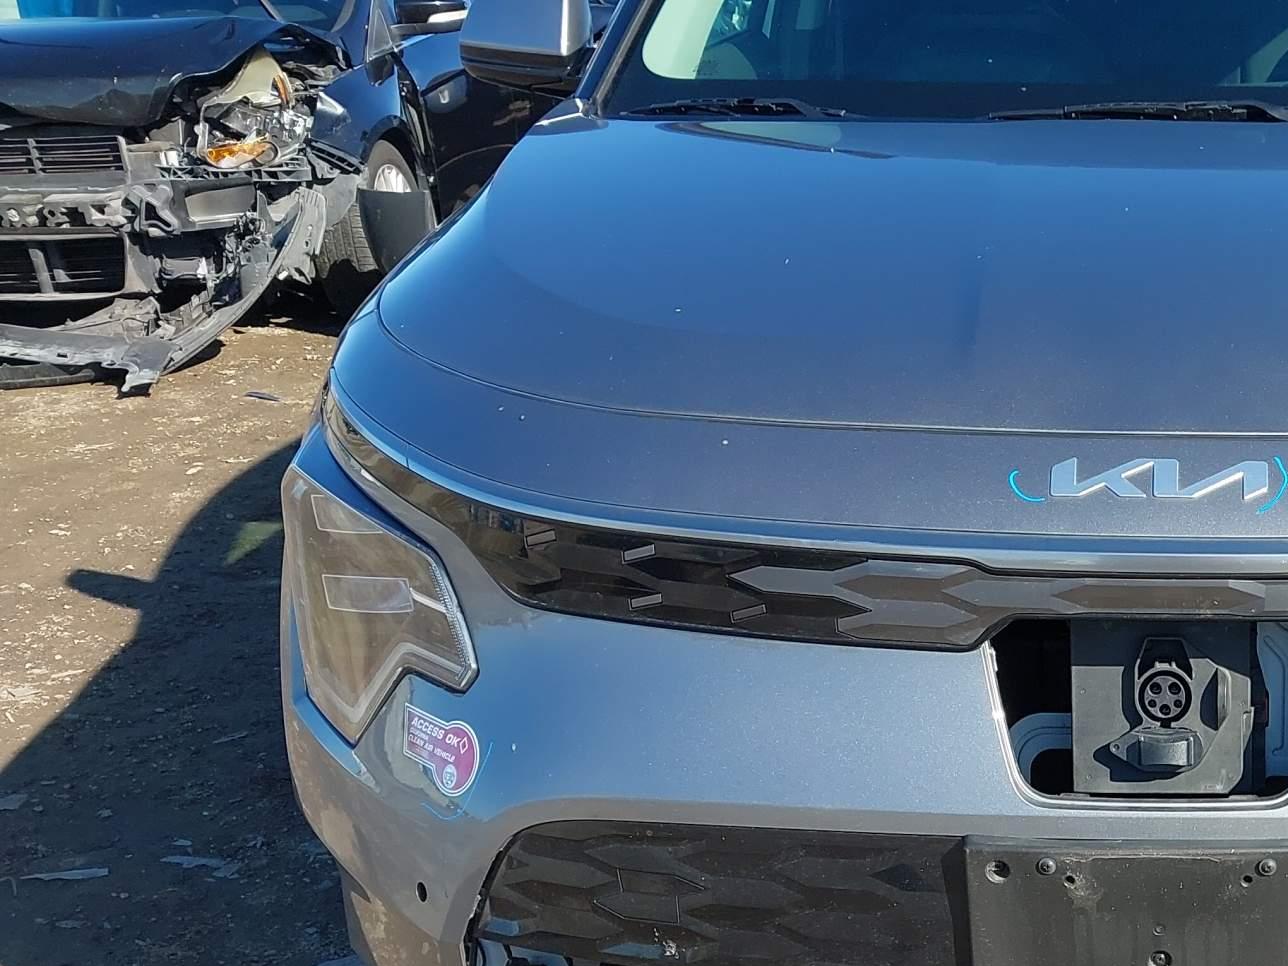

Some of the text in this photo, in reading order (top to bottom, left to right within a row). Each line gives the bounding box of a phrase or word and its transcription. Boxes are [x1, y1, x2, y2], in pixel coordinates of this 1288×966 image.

[1050, 457, 1269, 501] KIA
[411, 716, 461, 748] ACCESS OK
[408, 734, 425, 747] CLEAN
[424, 741, 434, 752] AIR
[433, 746, 456, 763] VEHICLE
